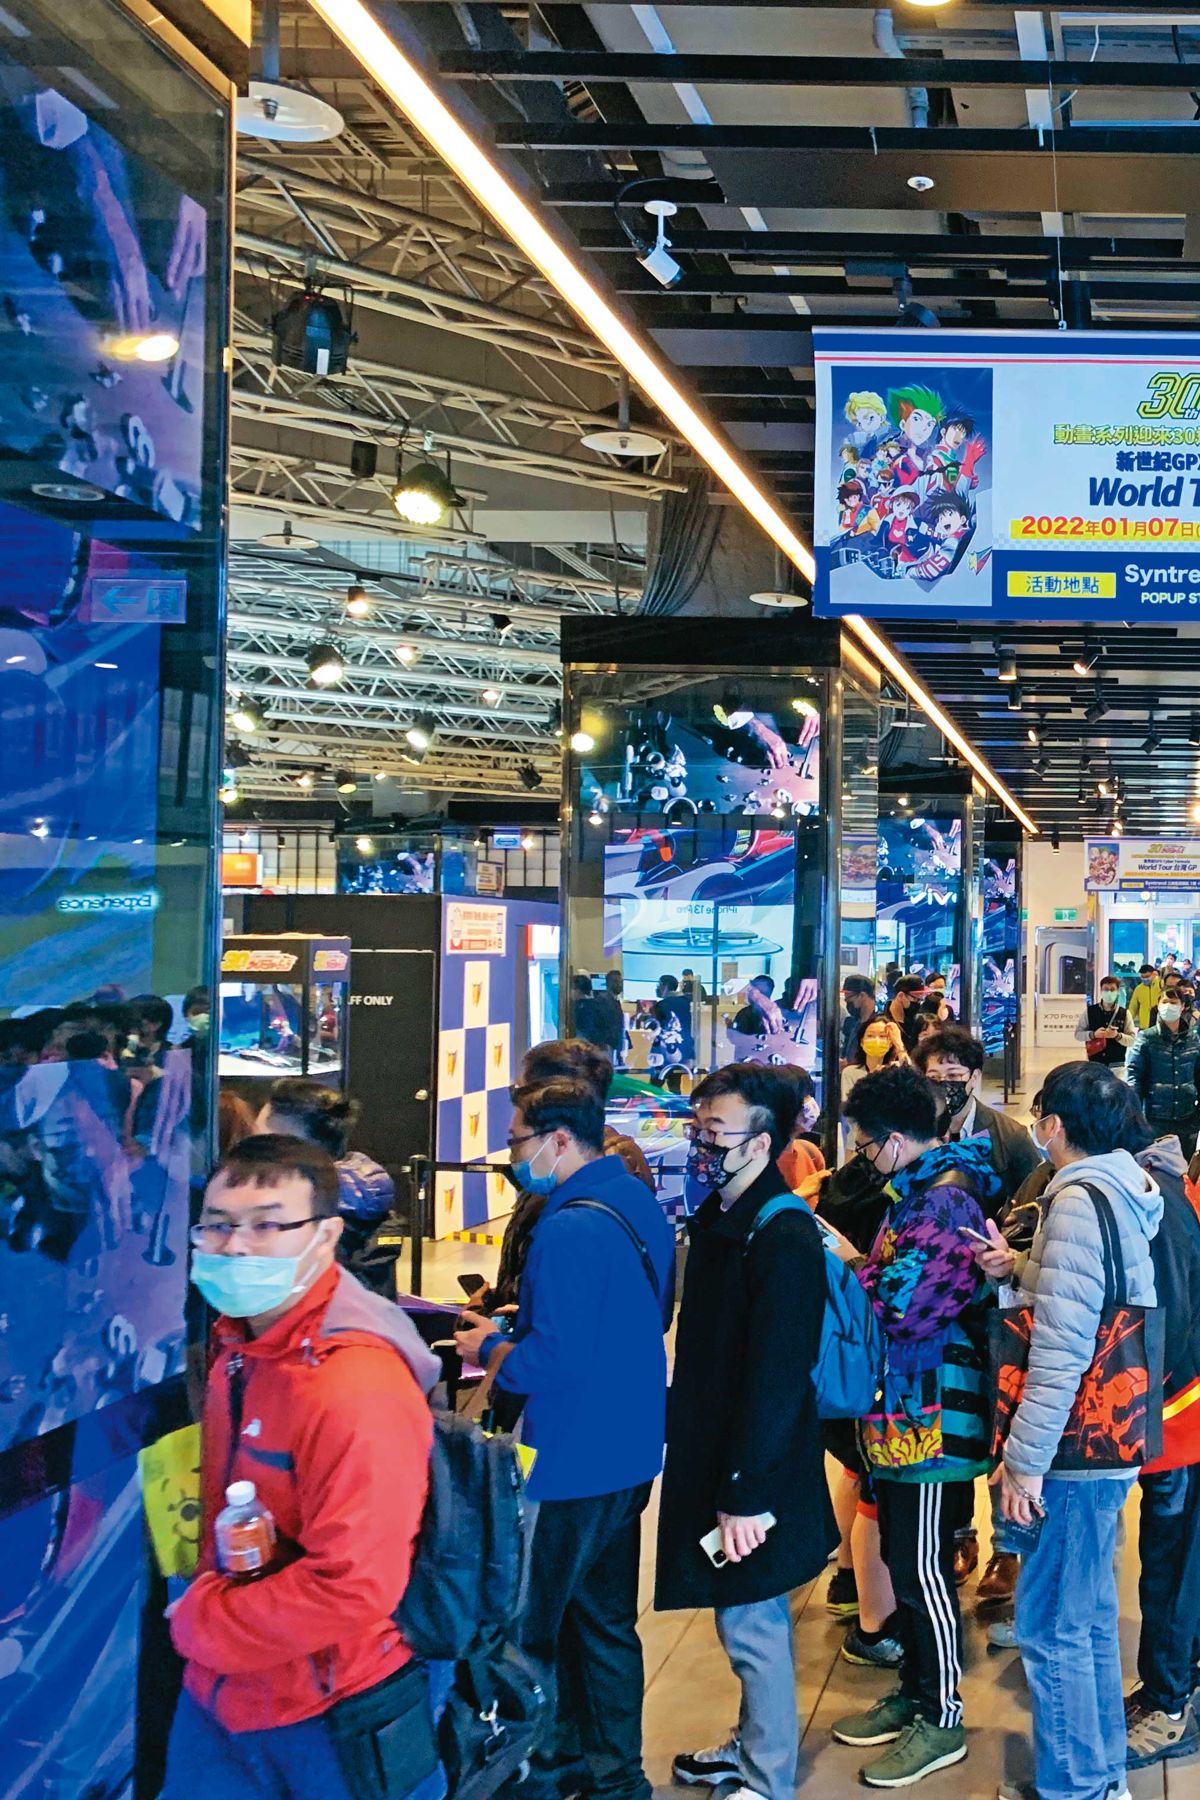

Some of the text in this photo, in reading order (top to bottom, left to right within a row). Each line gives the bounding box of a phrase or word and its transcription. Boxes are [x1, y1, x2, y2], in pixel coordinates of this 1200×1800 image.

[1089, 476, 1184, 507] World
[1026, 575, 1100, 594] 活動地點
[1141, 592, 1185, 604] POPUP
[363, 995, 394, 1006] ONLY
